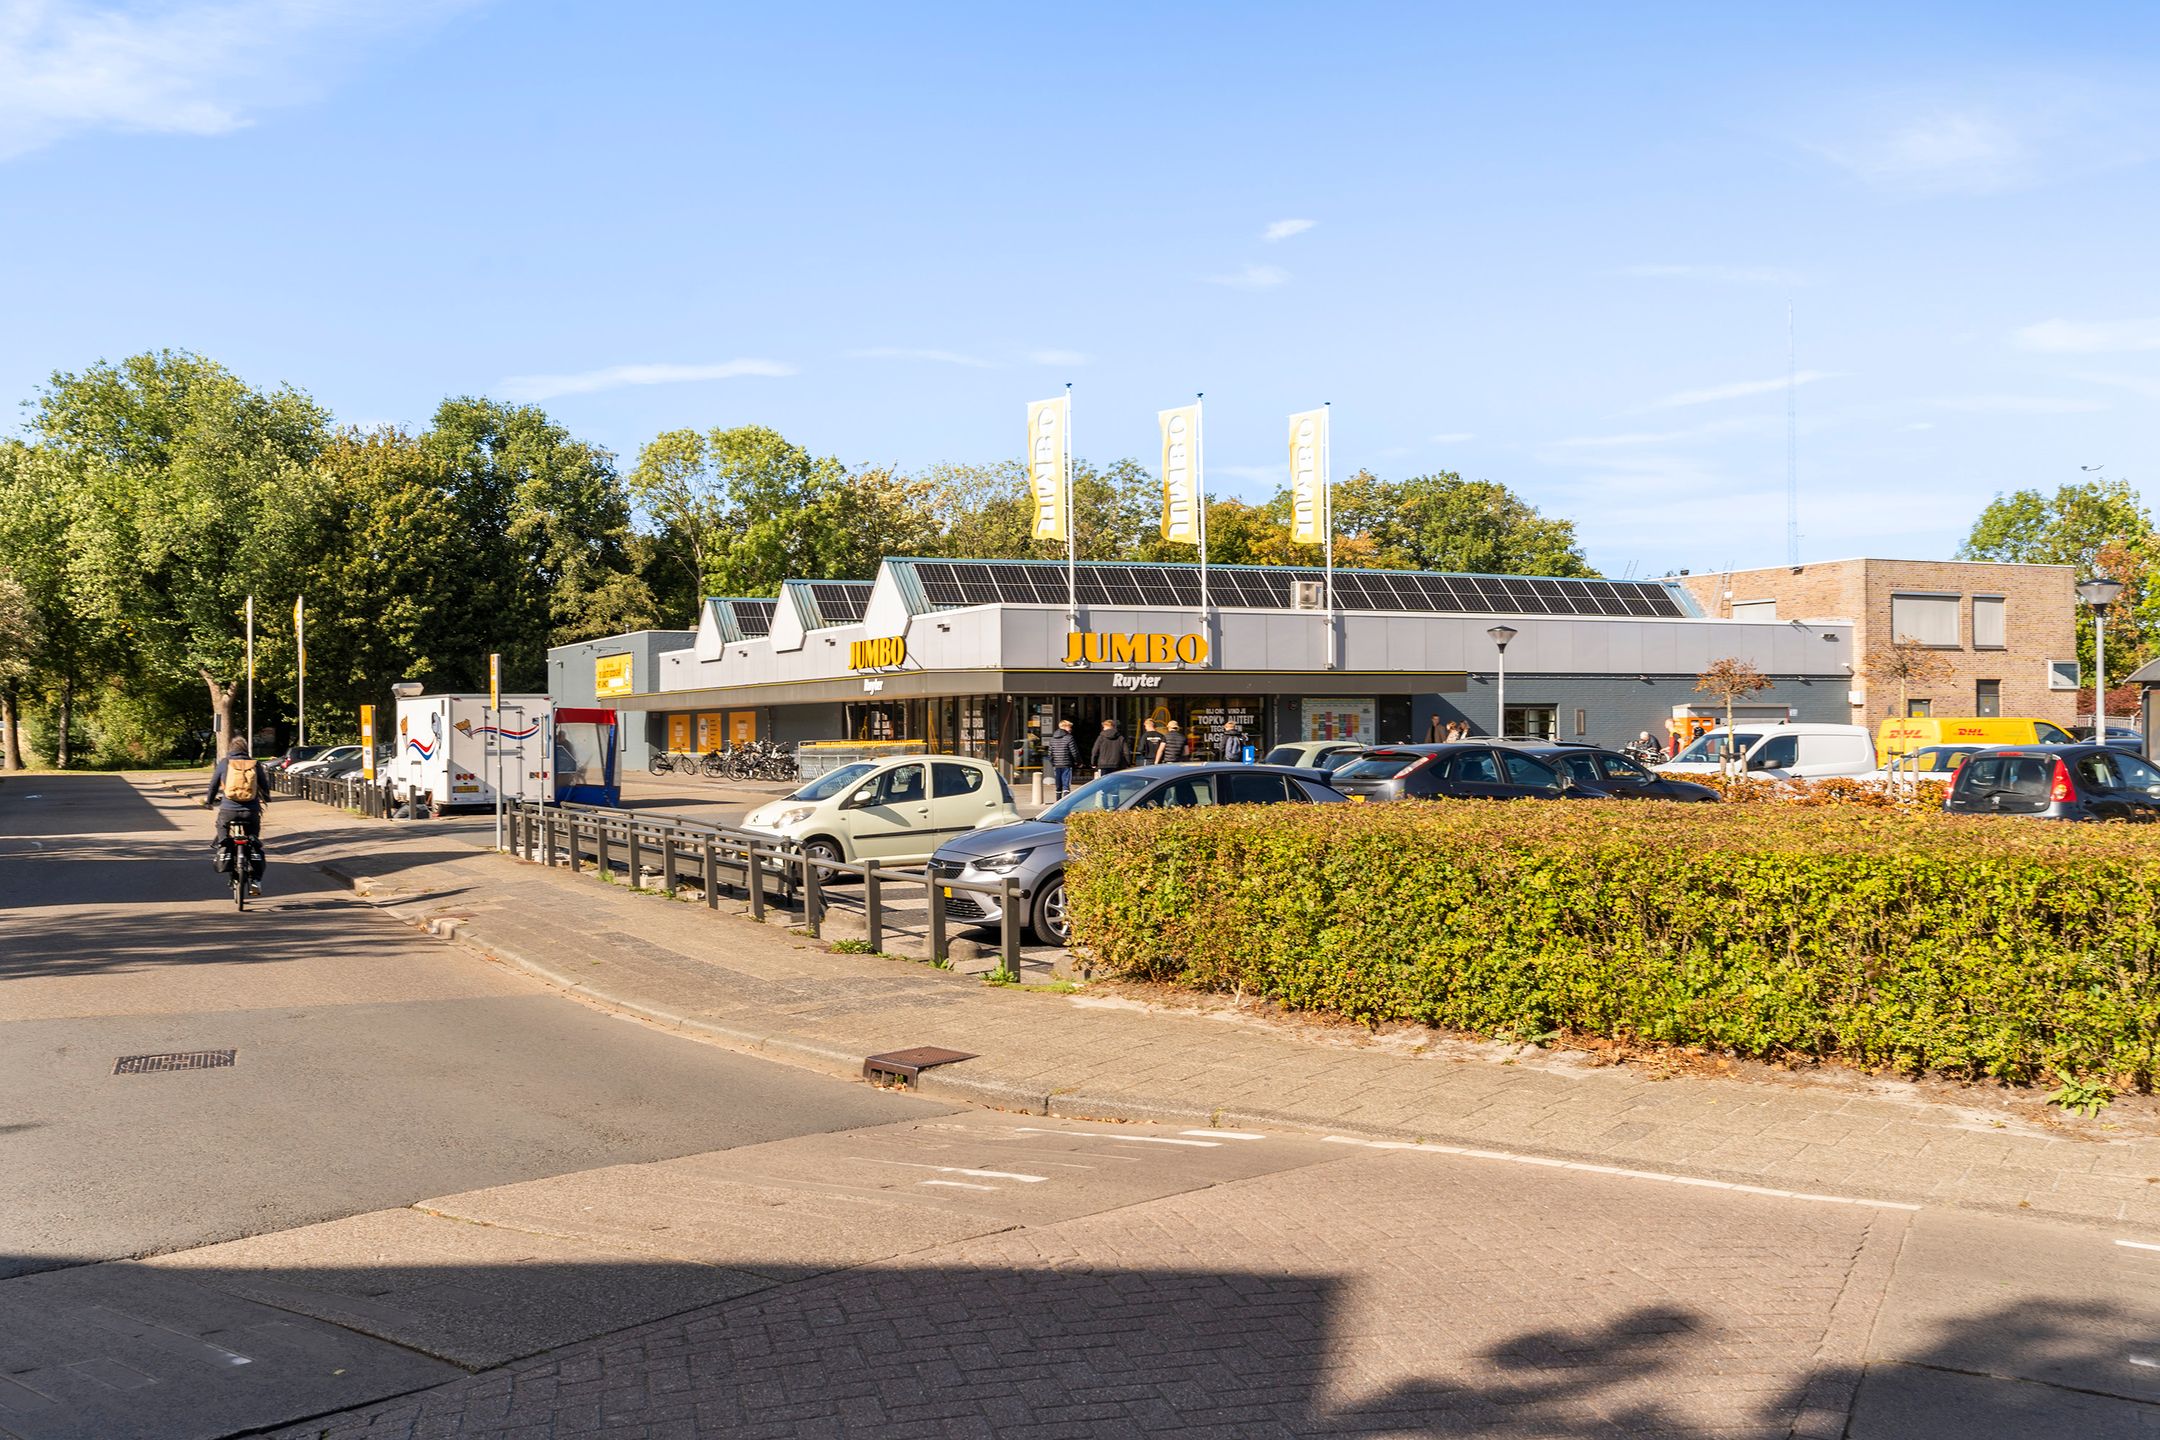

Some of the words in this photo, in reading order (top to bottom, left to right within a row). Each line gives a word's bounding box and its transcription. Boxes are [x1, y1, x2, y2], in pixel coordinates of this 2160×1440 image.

[847, 635, 907, 671] JUMBO
[1061, 632, 1209, 665] JUMBO
[1112, 673, 1161, 690] Ruyter
[1888, 729, 1922, 739] DHL
[1957, 728, 1985, 736] DHL
[1245, 749, 1251, 761] L
